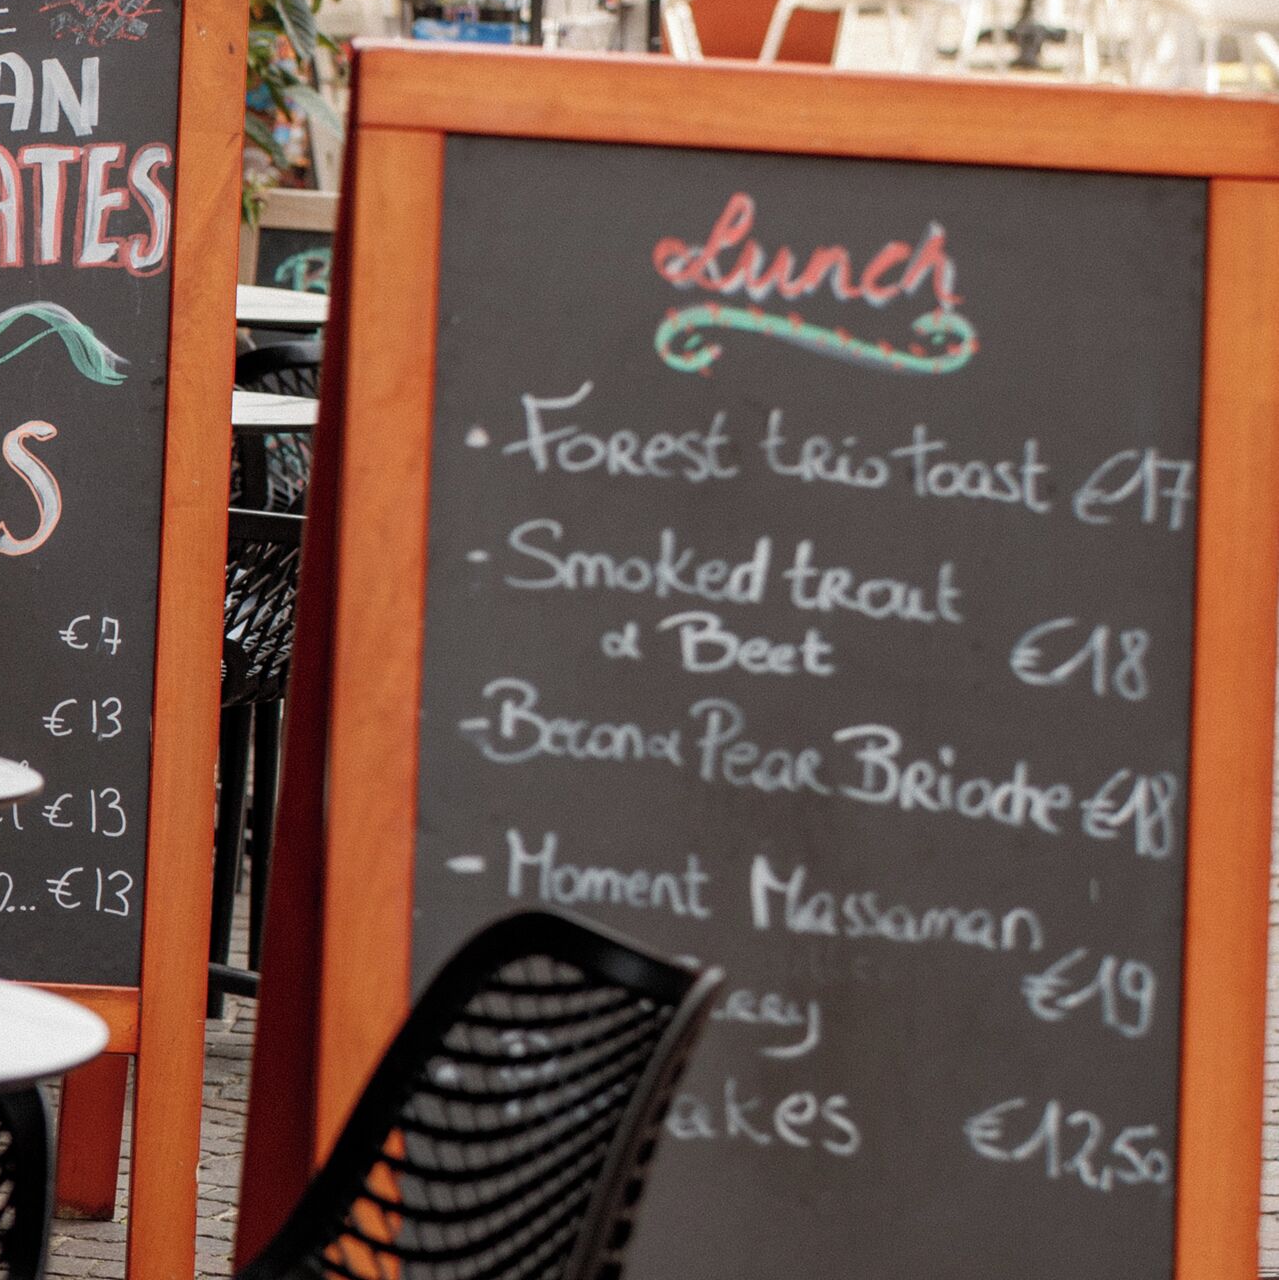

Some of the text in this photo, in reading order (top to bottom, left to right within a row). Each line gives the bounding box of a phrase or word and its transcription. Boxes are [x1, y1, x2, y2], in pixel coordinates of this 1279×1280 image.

[651, 191, 966, 312] Lunch
[502, 379, 737, 482] Forest
[893, 424, 1050, 513] toast
[1072, 448, 1193, 530] €17
[509, 519, 772, 603] Smoked
[659, 610, 833, 675] Beet
[1009, 617, 1148, 700] €18
[506, 828, 1042, 950] Moment Massaman
[1022, 949, 1156, 1037] €19
